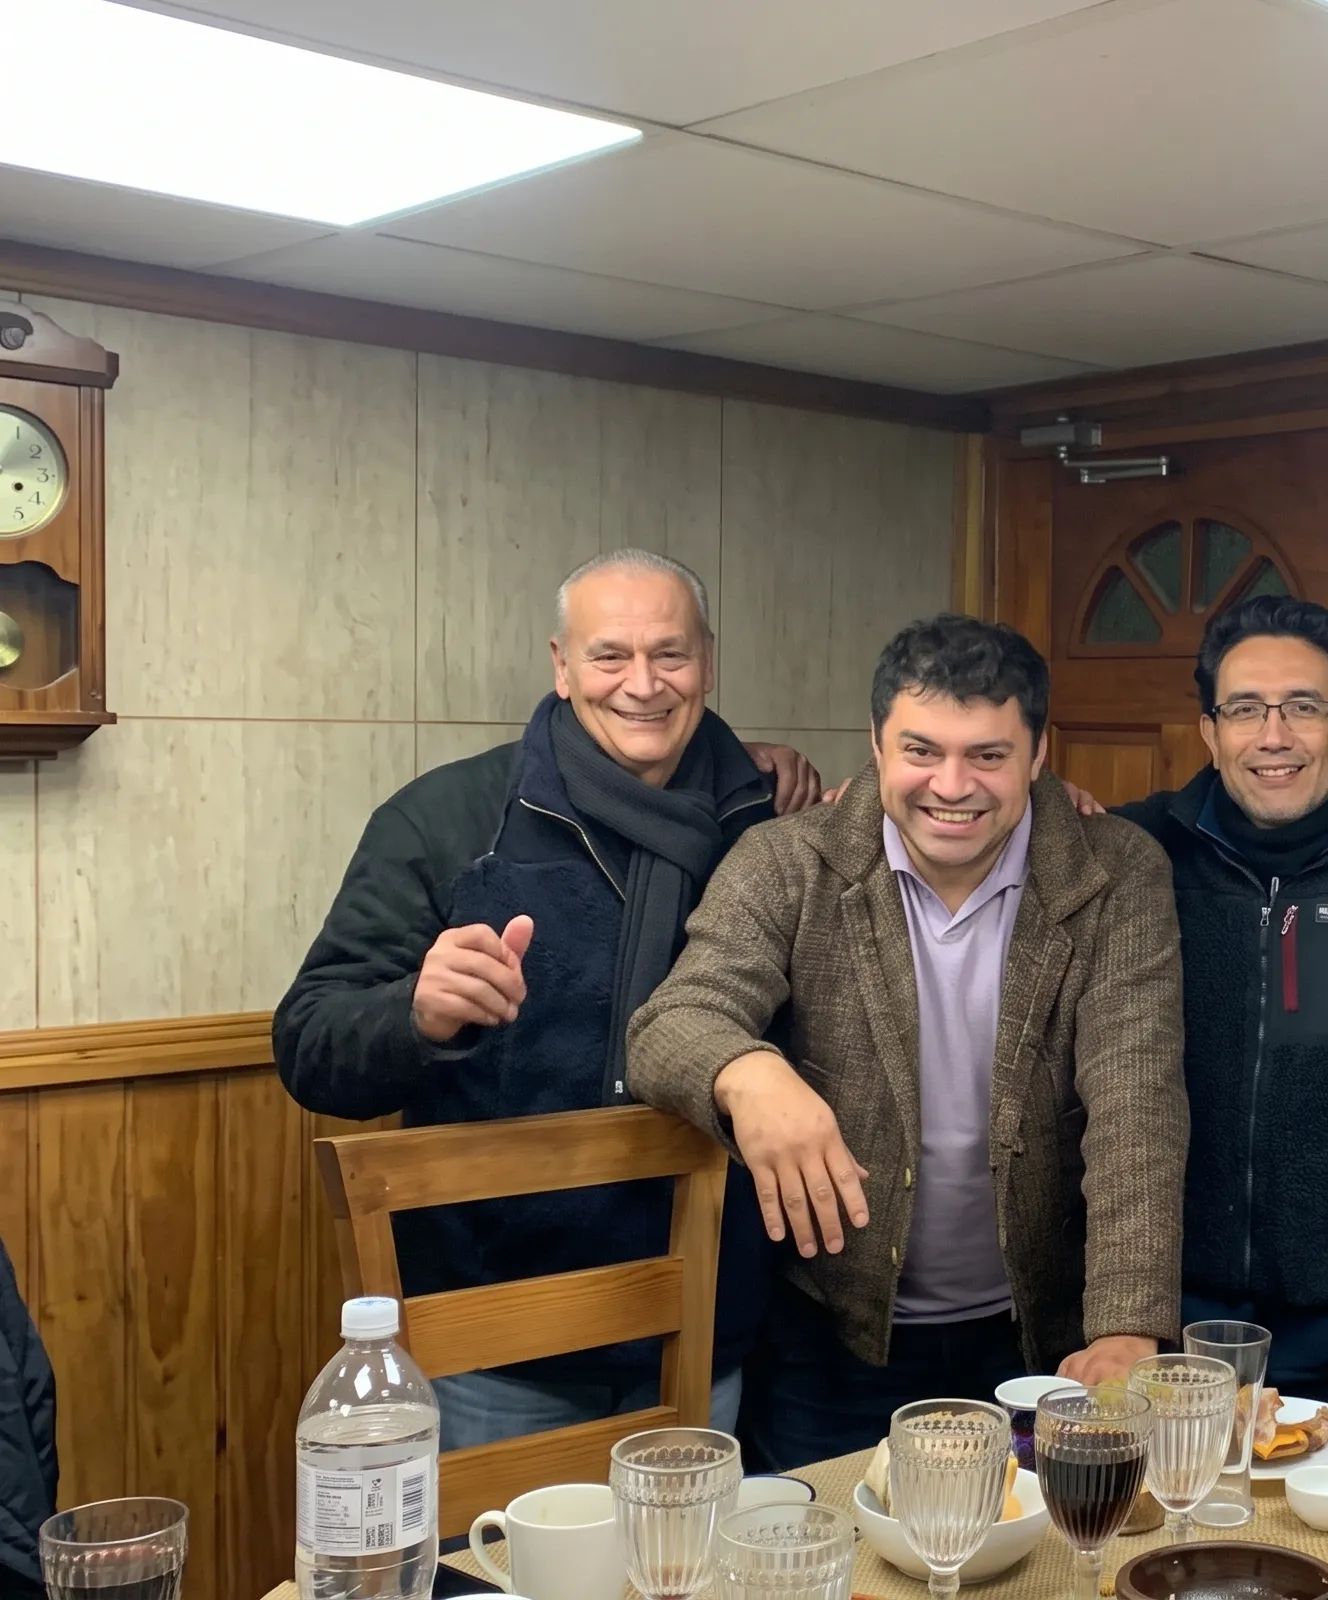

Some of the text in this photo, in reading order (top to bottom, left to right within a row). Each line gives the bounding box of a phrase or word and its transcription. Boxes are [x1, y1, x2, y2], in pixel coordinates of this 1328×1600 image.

[16, 425, 20, 440] 1
[29, 444, 42, 459] 2
[36, 467, 49, 483] 3
[28, 491, 42, 505] 4
[13, 507, 24, 520] 5
